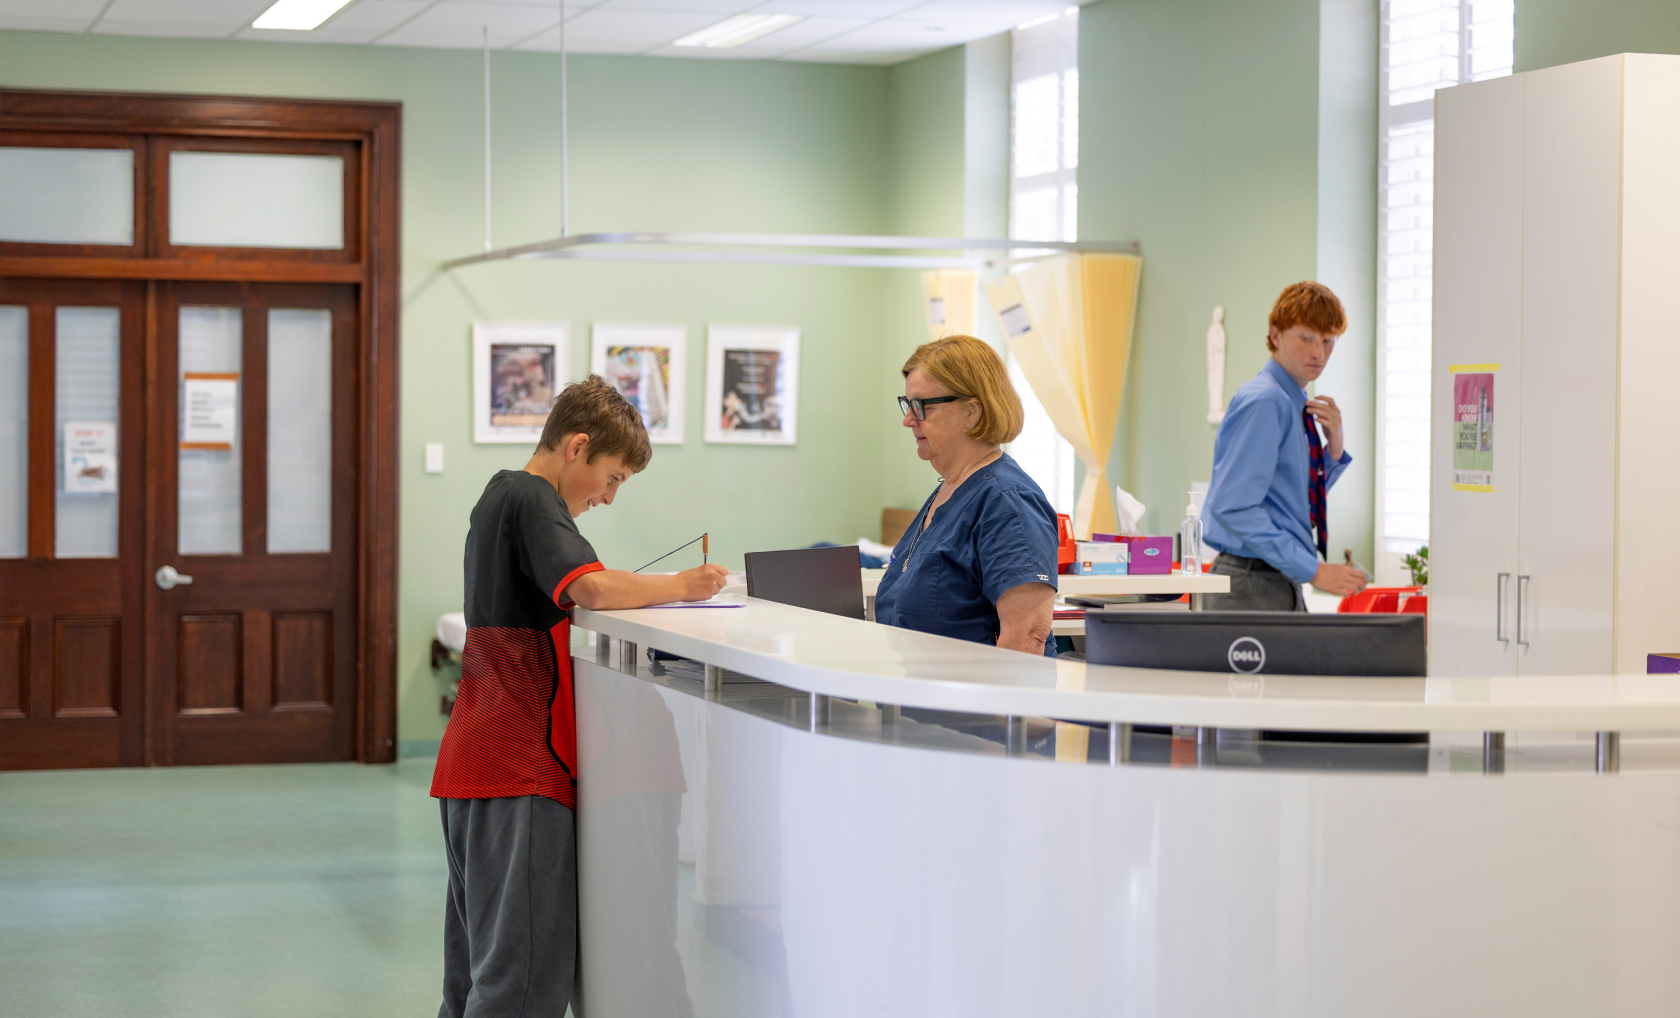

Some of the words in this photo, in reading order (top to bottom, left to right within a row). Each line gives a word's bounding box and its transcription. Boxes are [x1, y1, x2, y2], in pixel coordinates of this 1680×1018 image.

[1458, 404, 1467, 413] DO
[1467, 404, 1478, 413] YOU
[1461, 414, 1478, 422] KNOW
[1462, 423, 1478, 432] WHAT
[1459, 432, 1478, 441] YOU'RE
[1232, 650, 1261, 662] DELL
